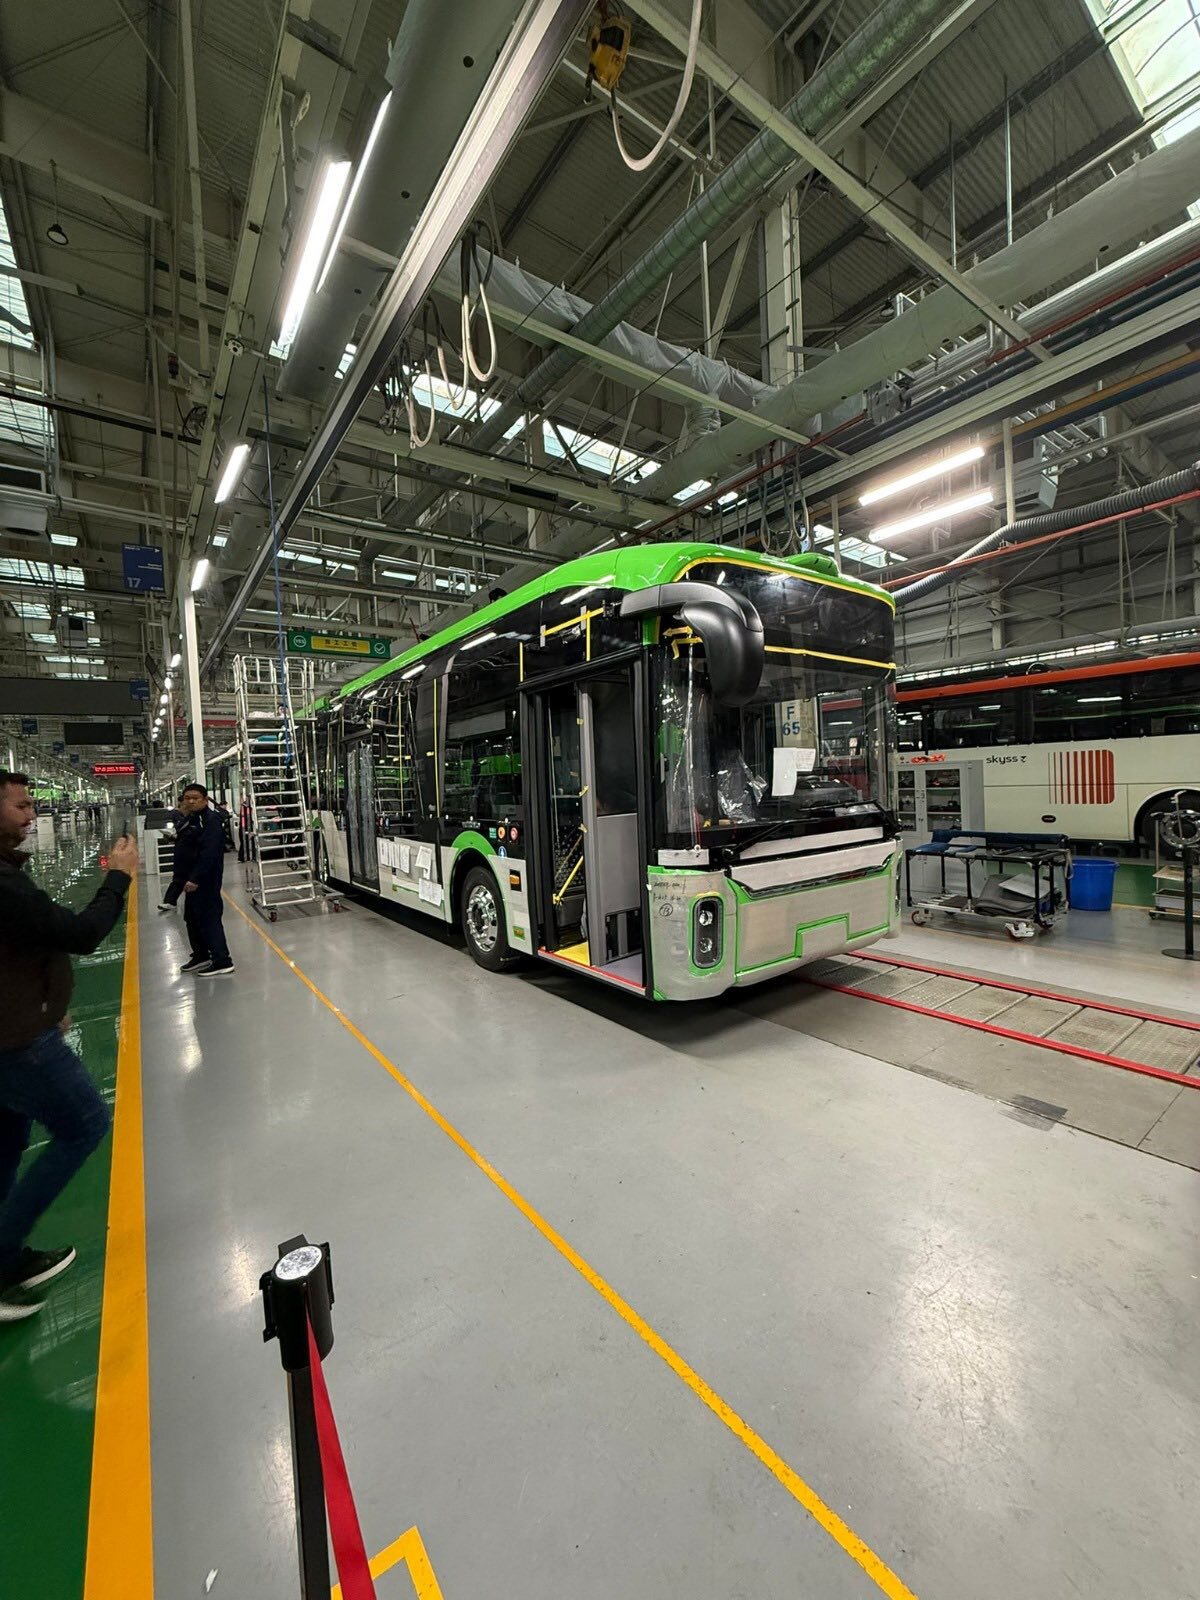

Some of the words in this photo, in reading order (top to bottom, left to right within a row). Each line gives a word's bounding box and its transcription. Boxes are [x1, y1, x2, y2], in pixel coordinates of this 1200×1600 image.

[127, 577, 141, 588] 17
[786, 706, 795, 720] F
[782, 721, 801, 736] 65
[986, 755, 1018, 765] skyss
